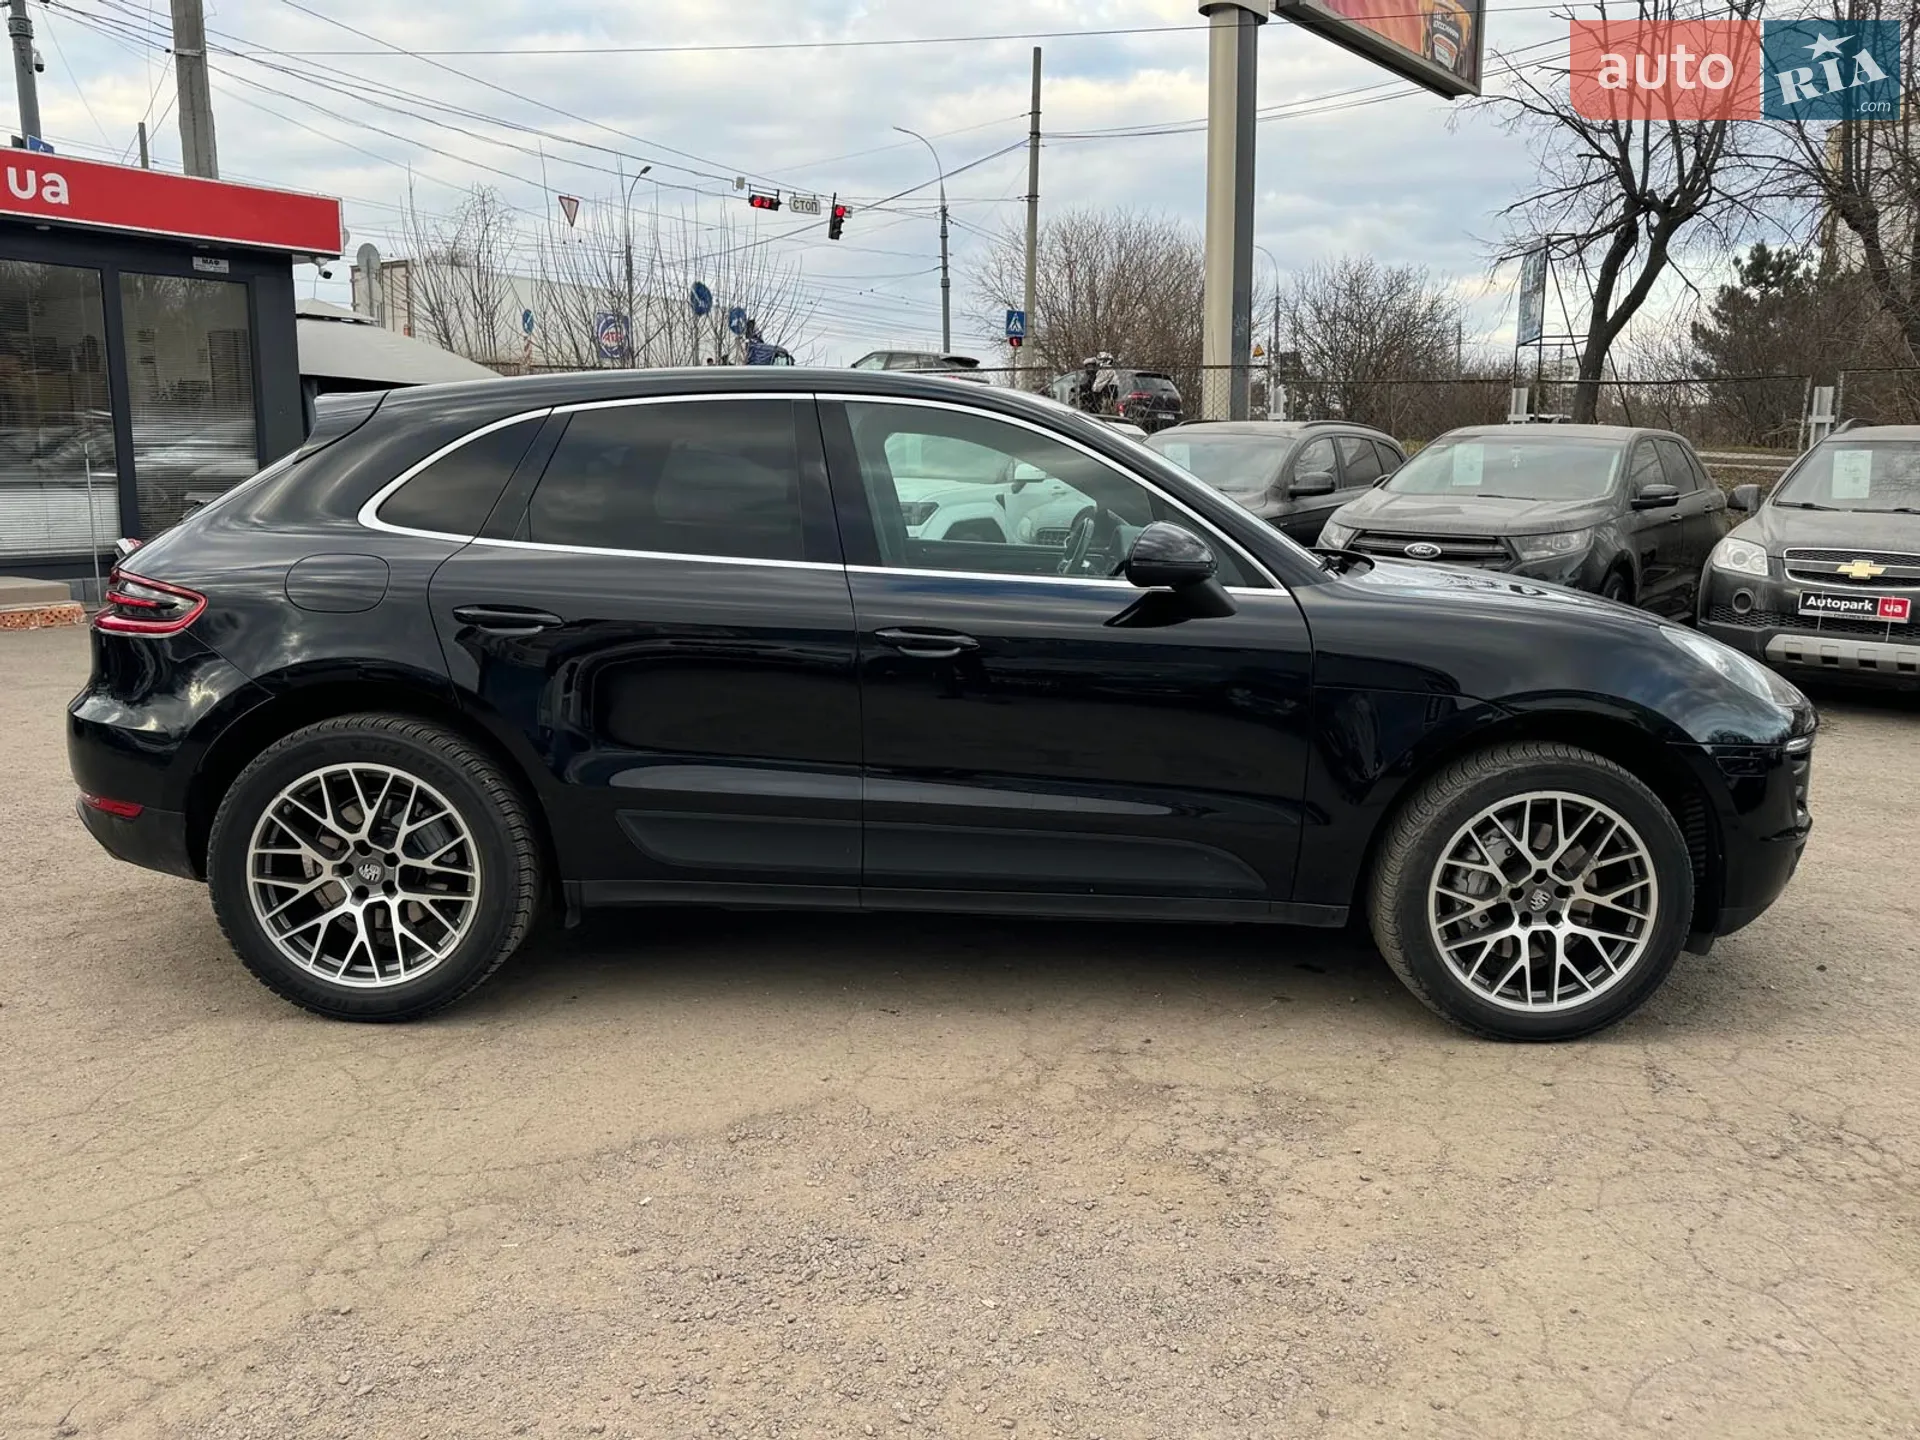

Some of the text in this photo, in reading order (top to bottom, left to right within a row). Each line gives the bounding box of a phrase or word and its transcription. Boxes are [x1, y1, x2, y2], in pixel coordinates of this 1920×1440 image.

[7, 166, 69, 205] ua
[793, 200, 818, 212] СТОП
[1806, 595, 1902, 613] Autopark ua
